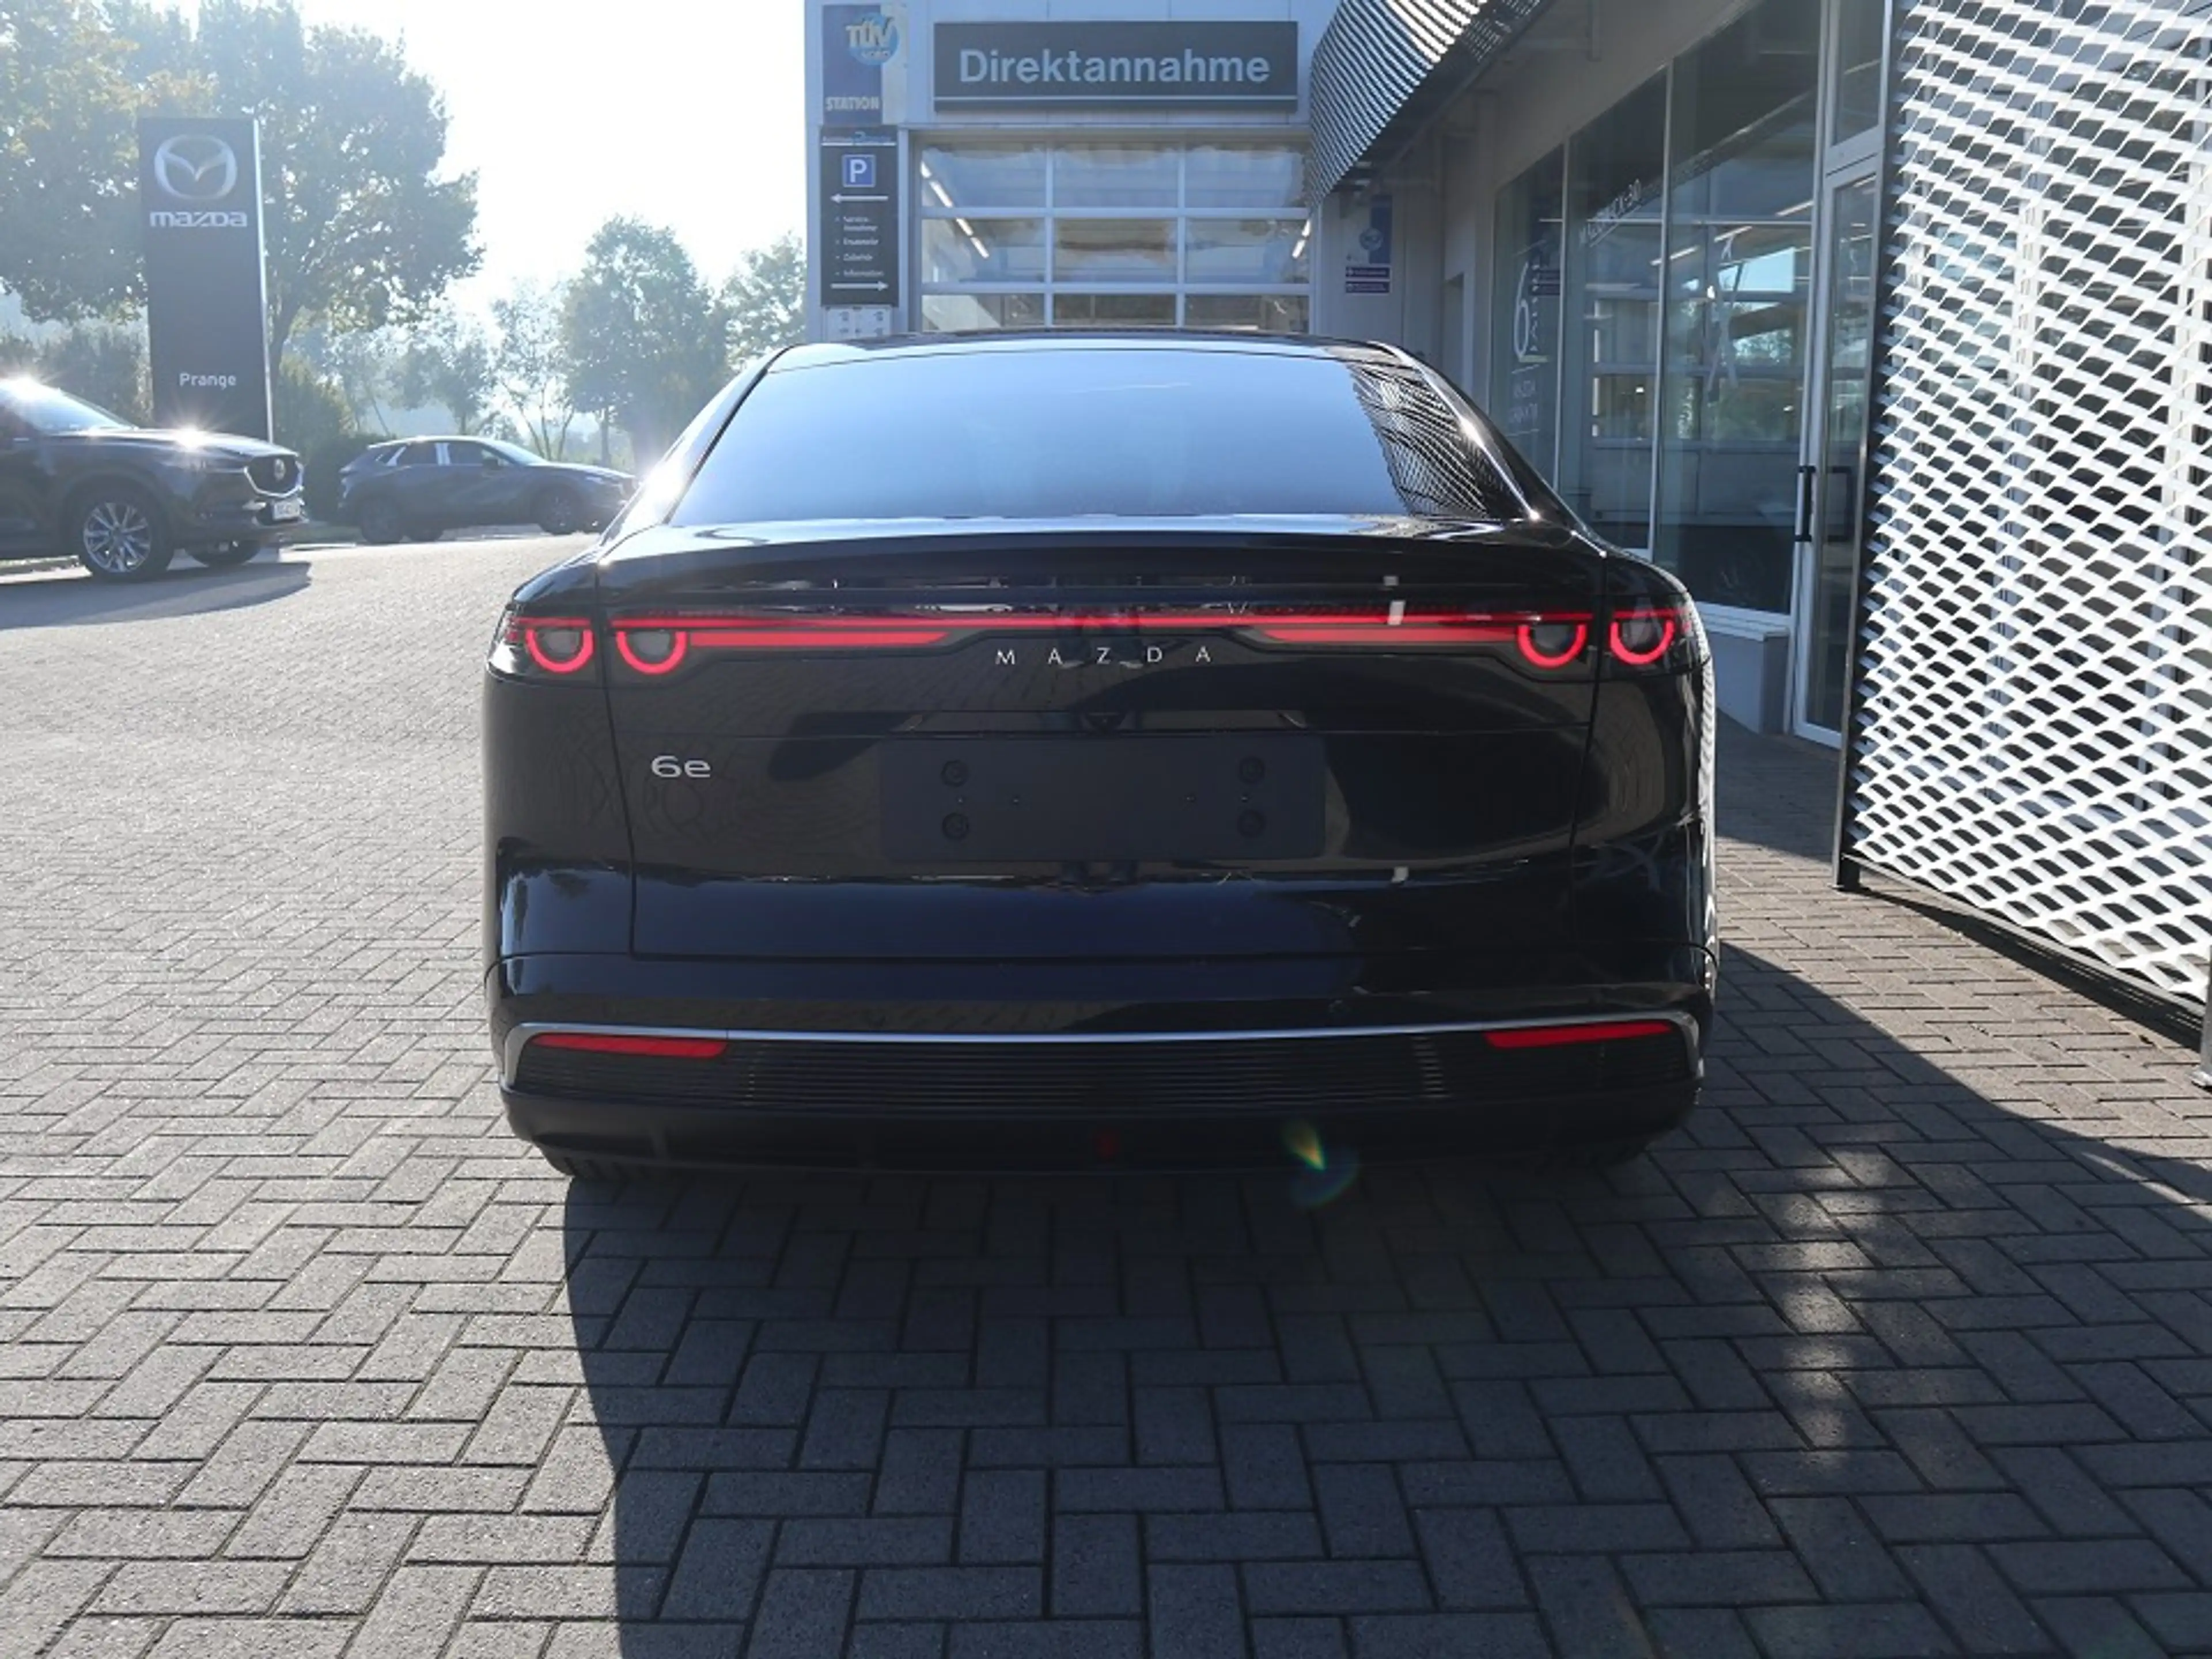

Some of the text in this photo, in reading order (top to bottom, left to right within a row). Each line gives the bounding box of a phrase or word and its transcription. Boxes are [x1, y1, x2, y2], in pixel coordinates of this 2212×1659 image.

[959, 48, 1271, 84] Direktannahme
[825, 96, 880, 110] STATION
[850, 159, 867, 183] P
[179, 372, 237, 389] Prange
[995, 645, 1211, 665] MAZDA
[652, 755, 711, 778] 6e
